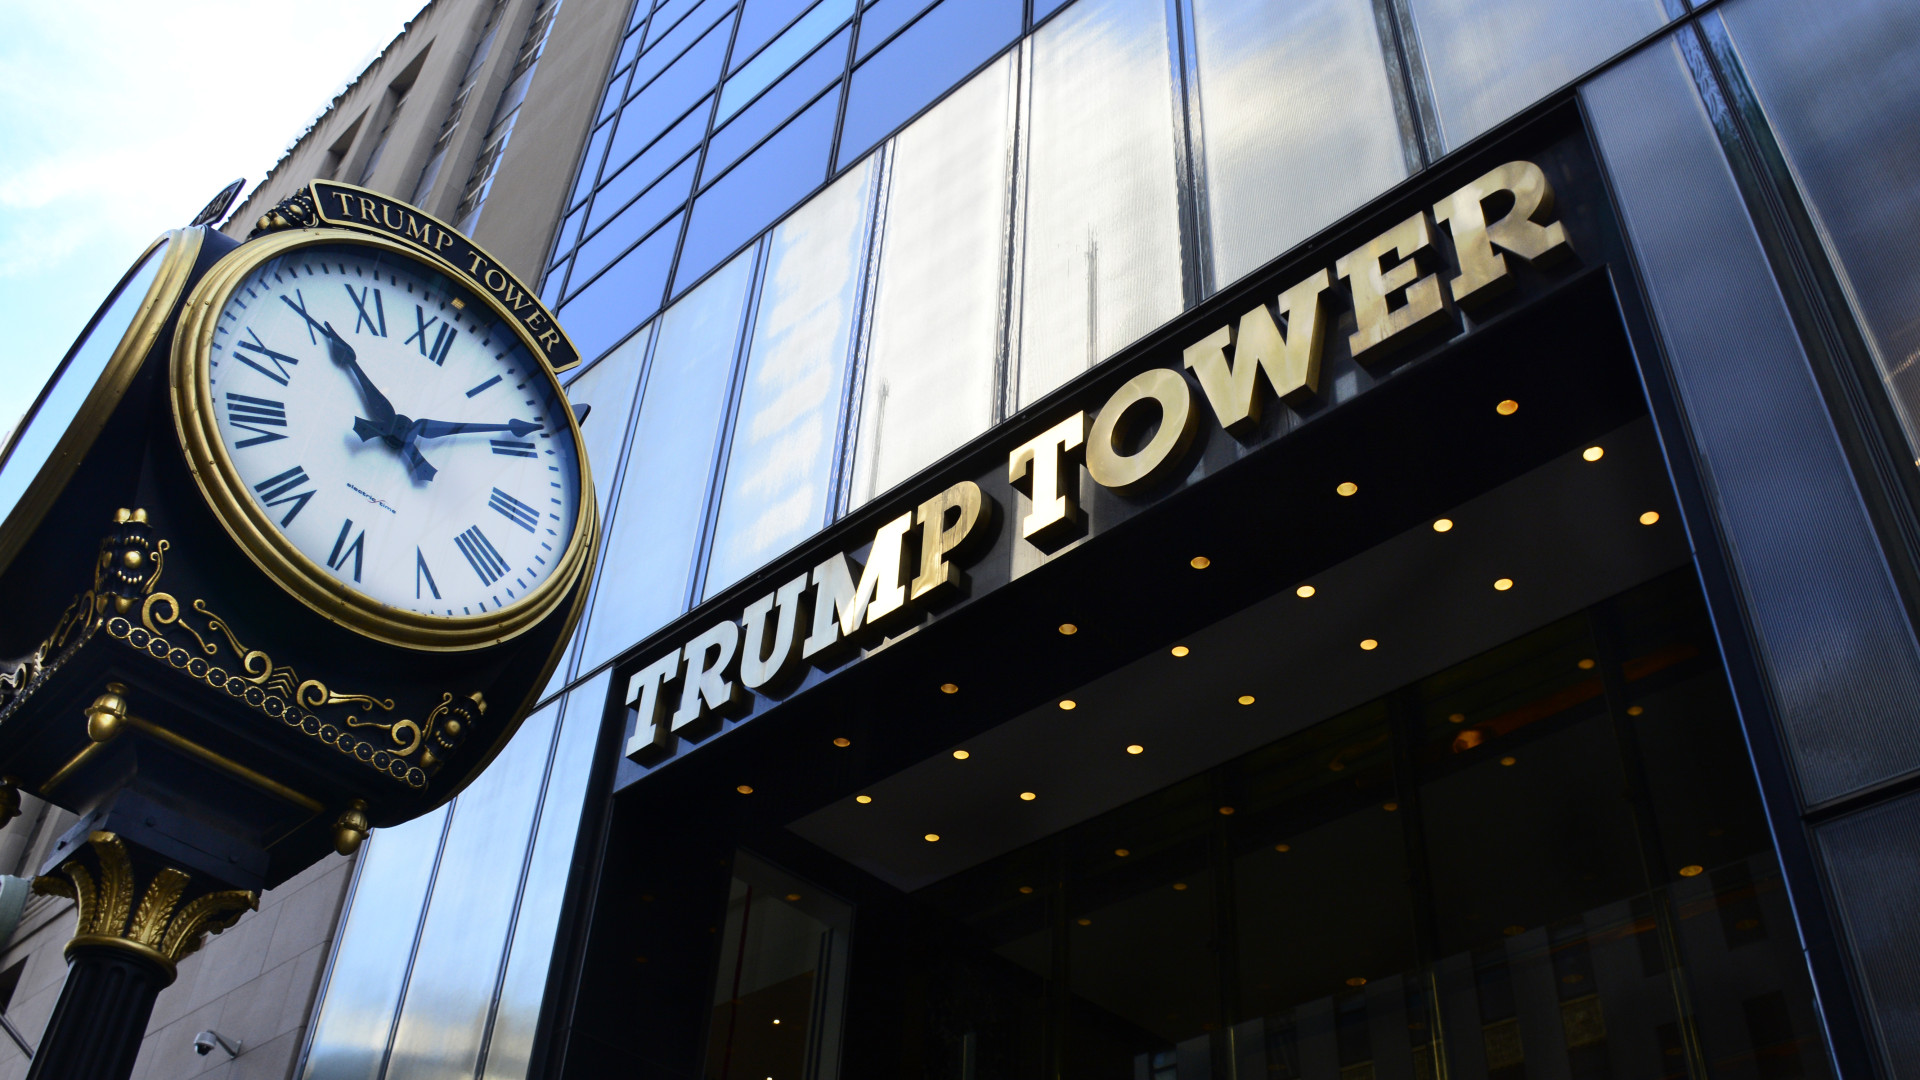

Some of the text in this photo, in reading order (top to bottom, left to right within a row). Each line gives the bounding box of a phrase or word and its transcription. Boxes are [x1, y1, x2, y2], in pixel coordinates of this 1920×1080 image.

[332, 191, 560, 353] TRUMP TOWER
[344, 283, 388, 338] XI
[404, 304, 458, 367] XII
[233, 326, 299, 387] IX
[226, 391, 289, 449] VIII
[625, 159, 1573, 765] TRUMP TOWER
[254, 465, 317, 529] VII
[488, 486, 541, 534] III
[326, 518, 366, 584] VI
[416, 544, 442, 600] V
[453, 524, 511, 587] IIII
